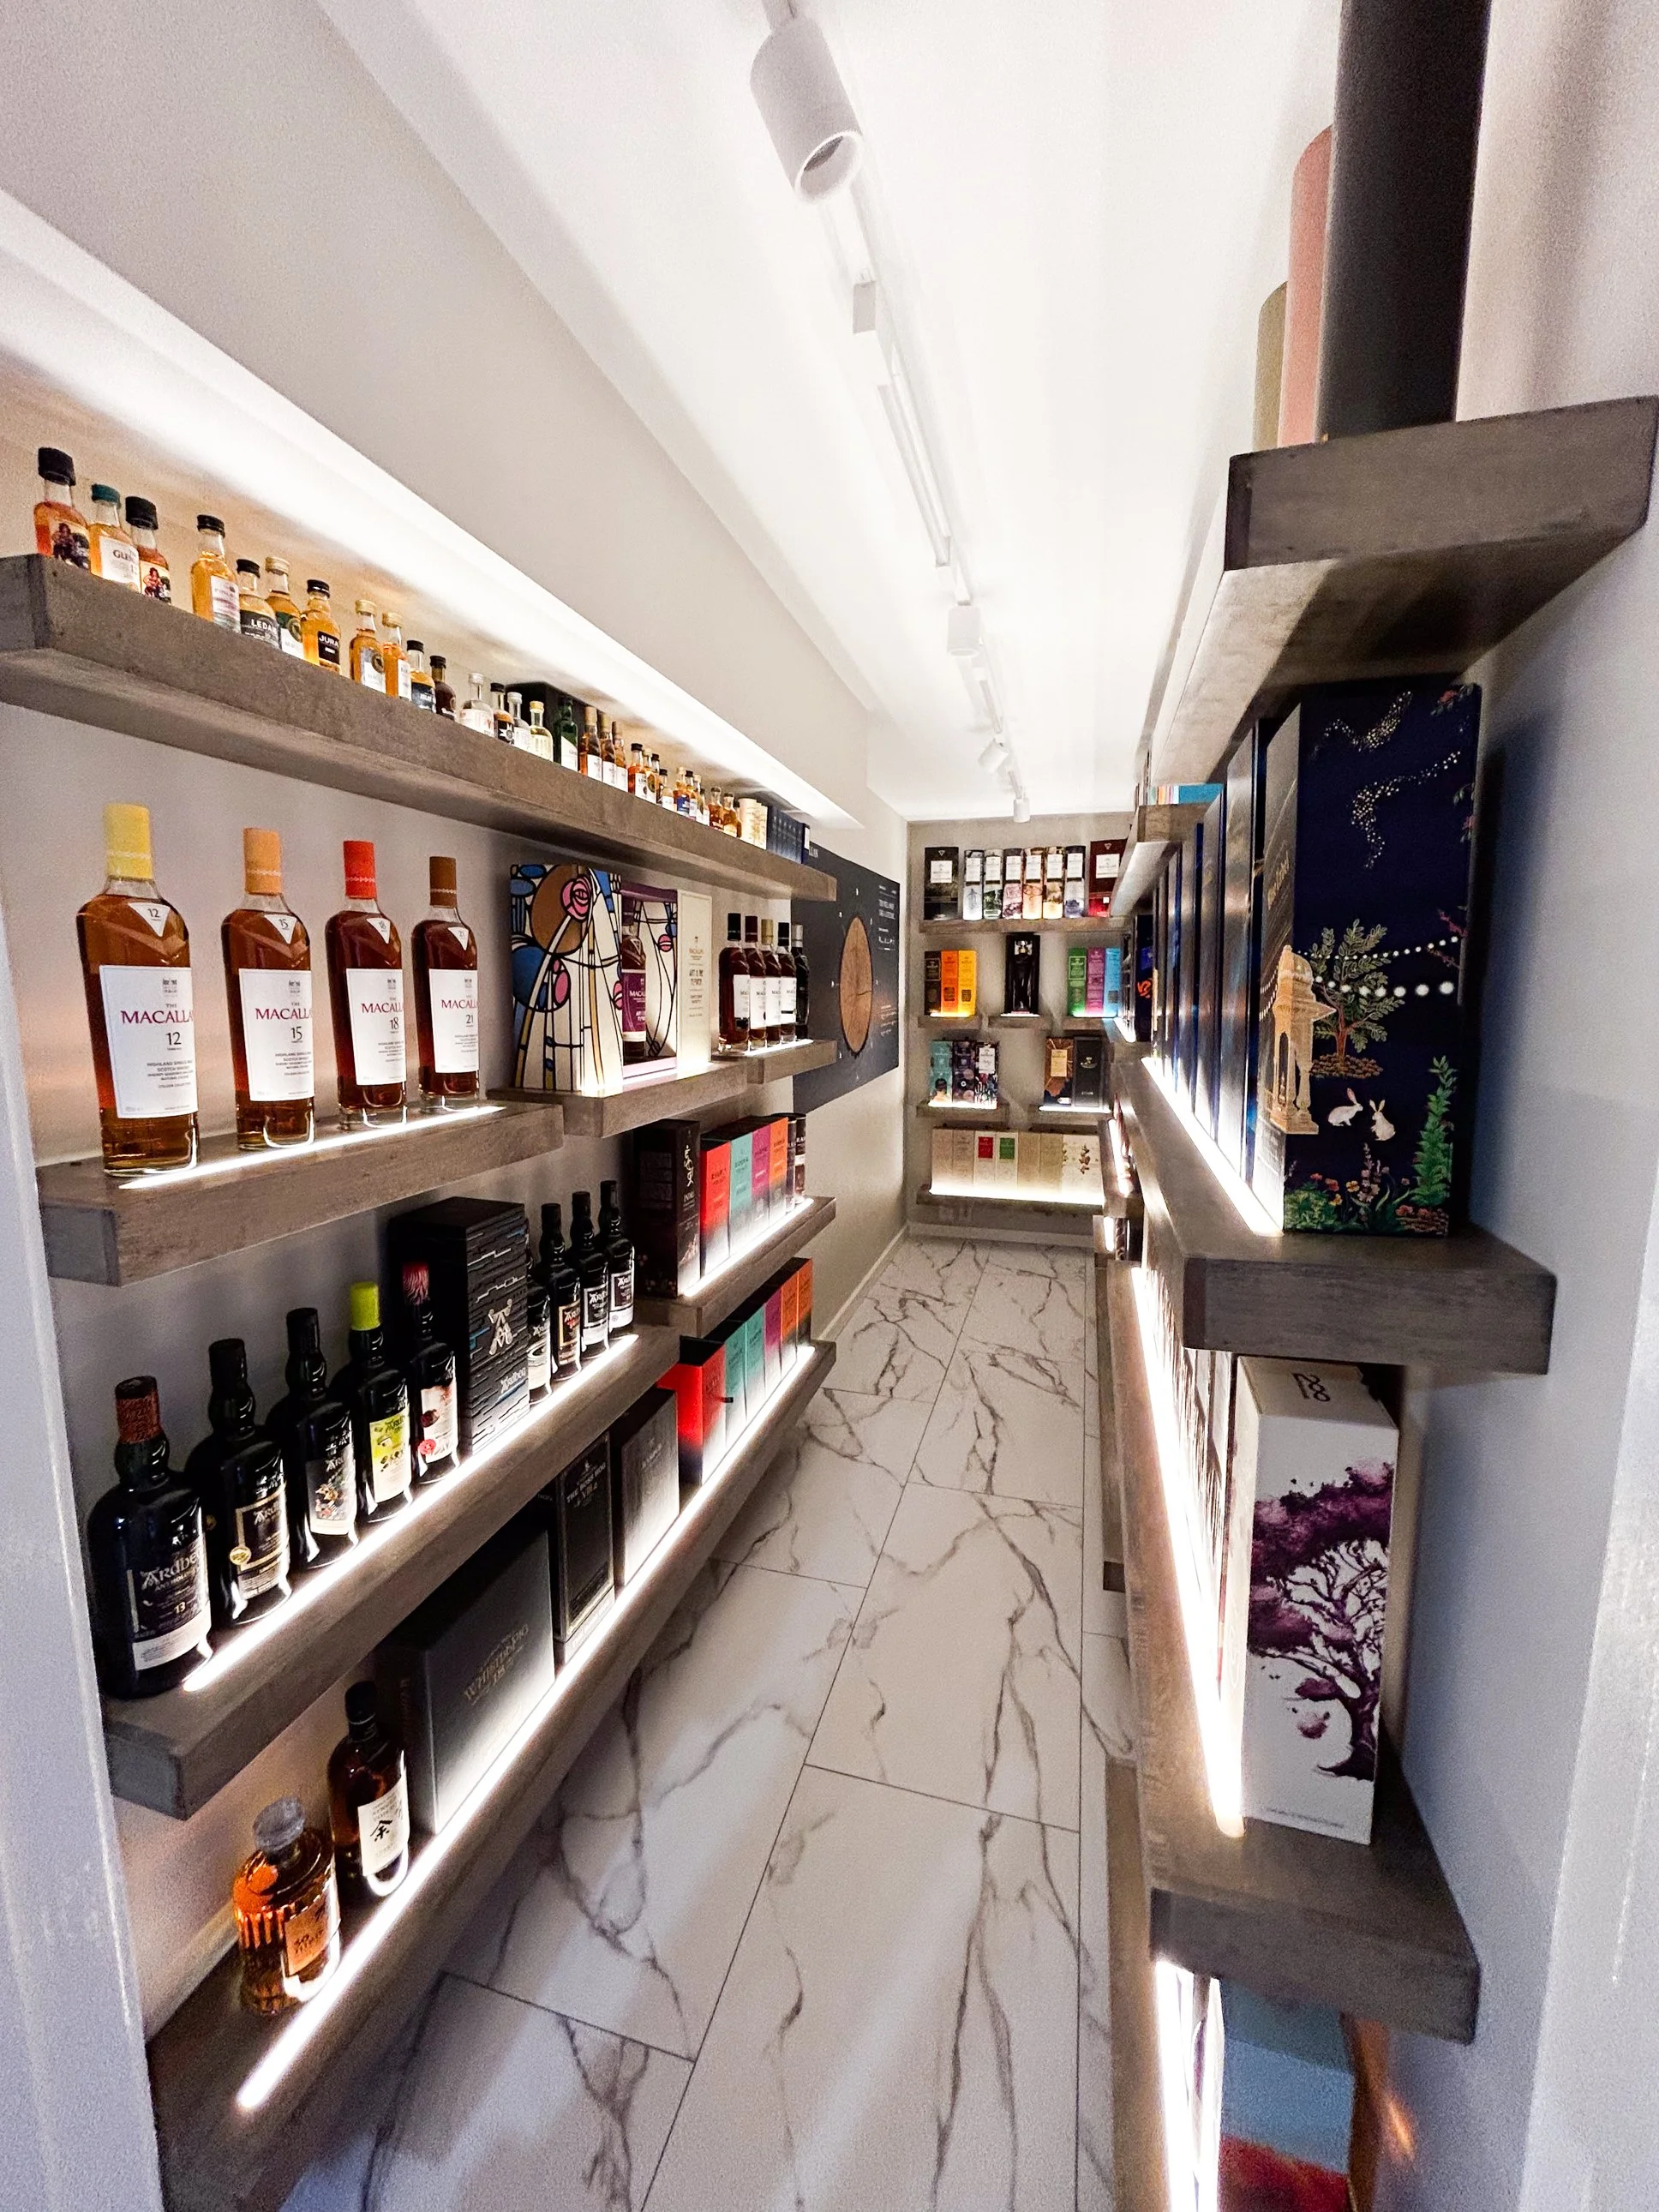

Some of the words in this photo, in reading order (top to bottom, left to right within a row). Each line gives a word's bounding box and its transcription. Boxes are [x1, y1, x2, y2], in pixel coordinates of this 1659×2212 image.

[319, 634, 338, 647] JURA
[147, 908, 160, 918] 12
[278, 919, 289, 928] 15
[255, 1008, 311, 1020] MACALL
[362, 1003, 403, 1013] MACALL
[390, 1017, 399, 1030] 18
[465, 1014, 473, 1024] 21
[166, 1032, 182, 1046] 12
[290, 1027, 302, 1041] 15
[175, 1601, 186, 1614] 13
